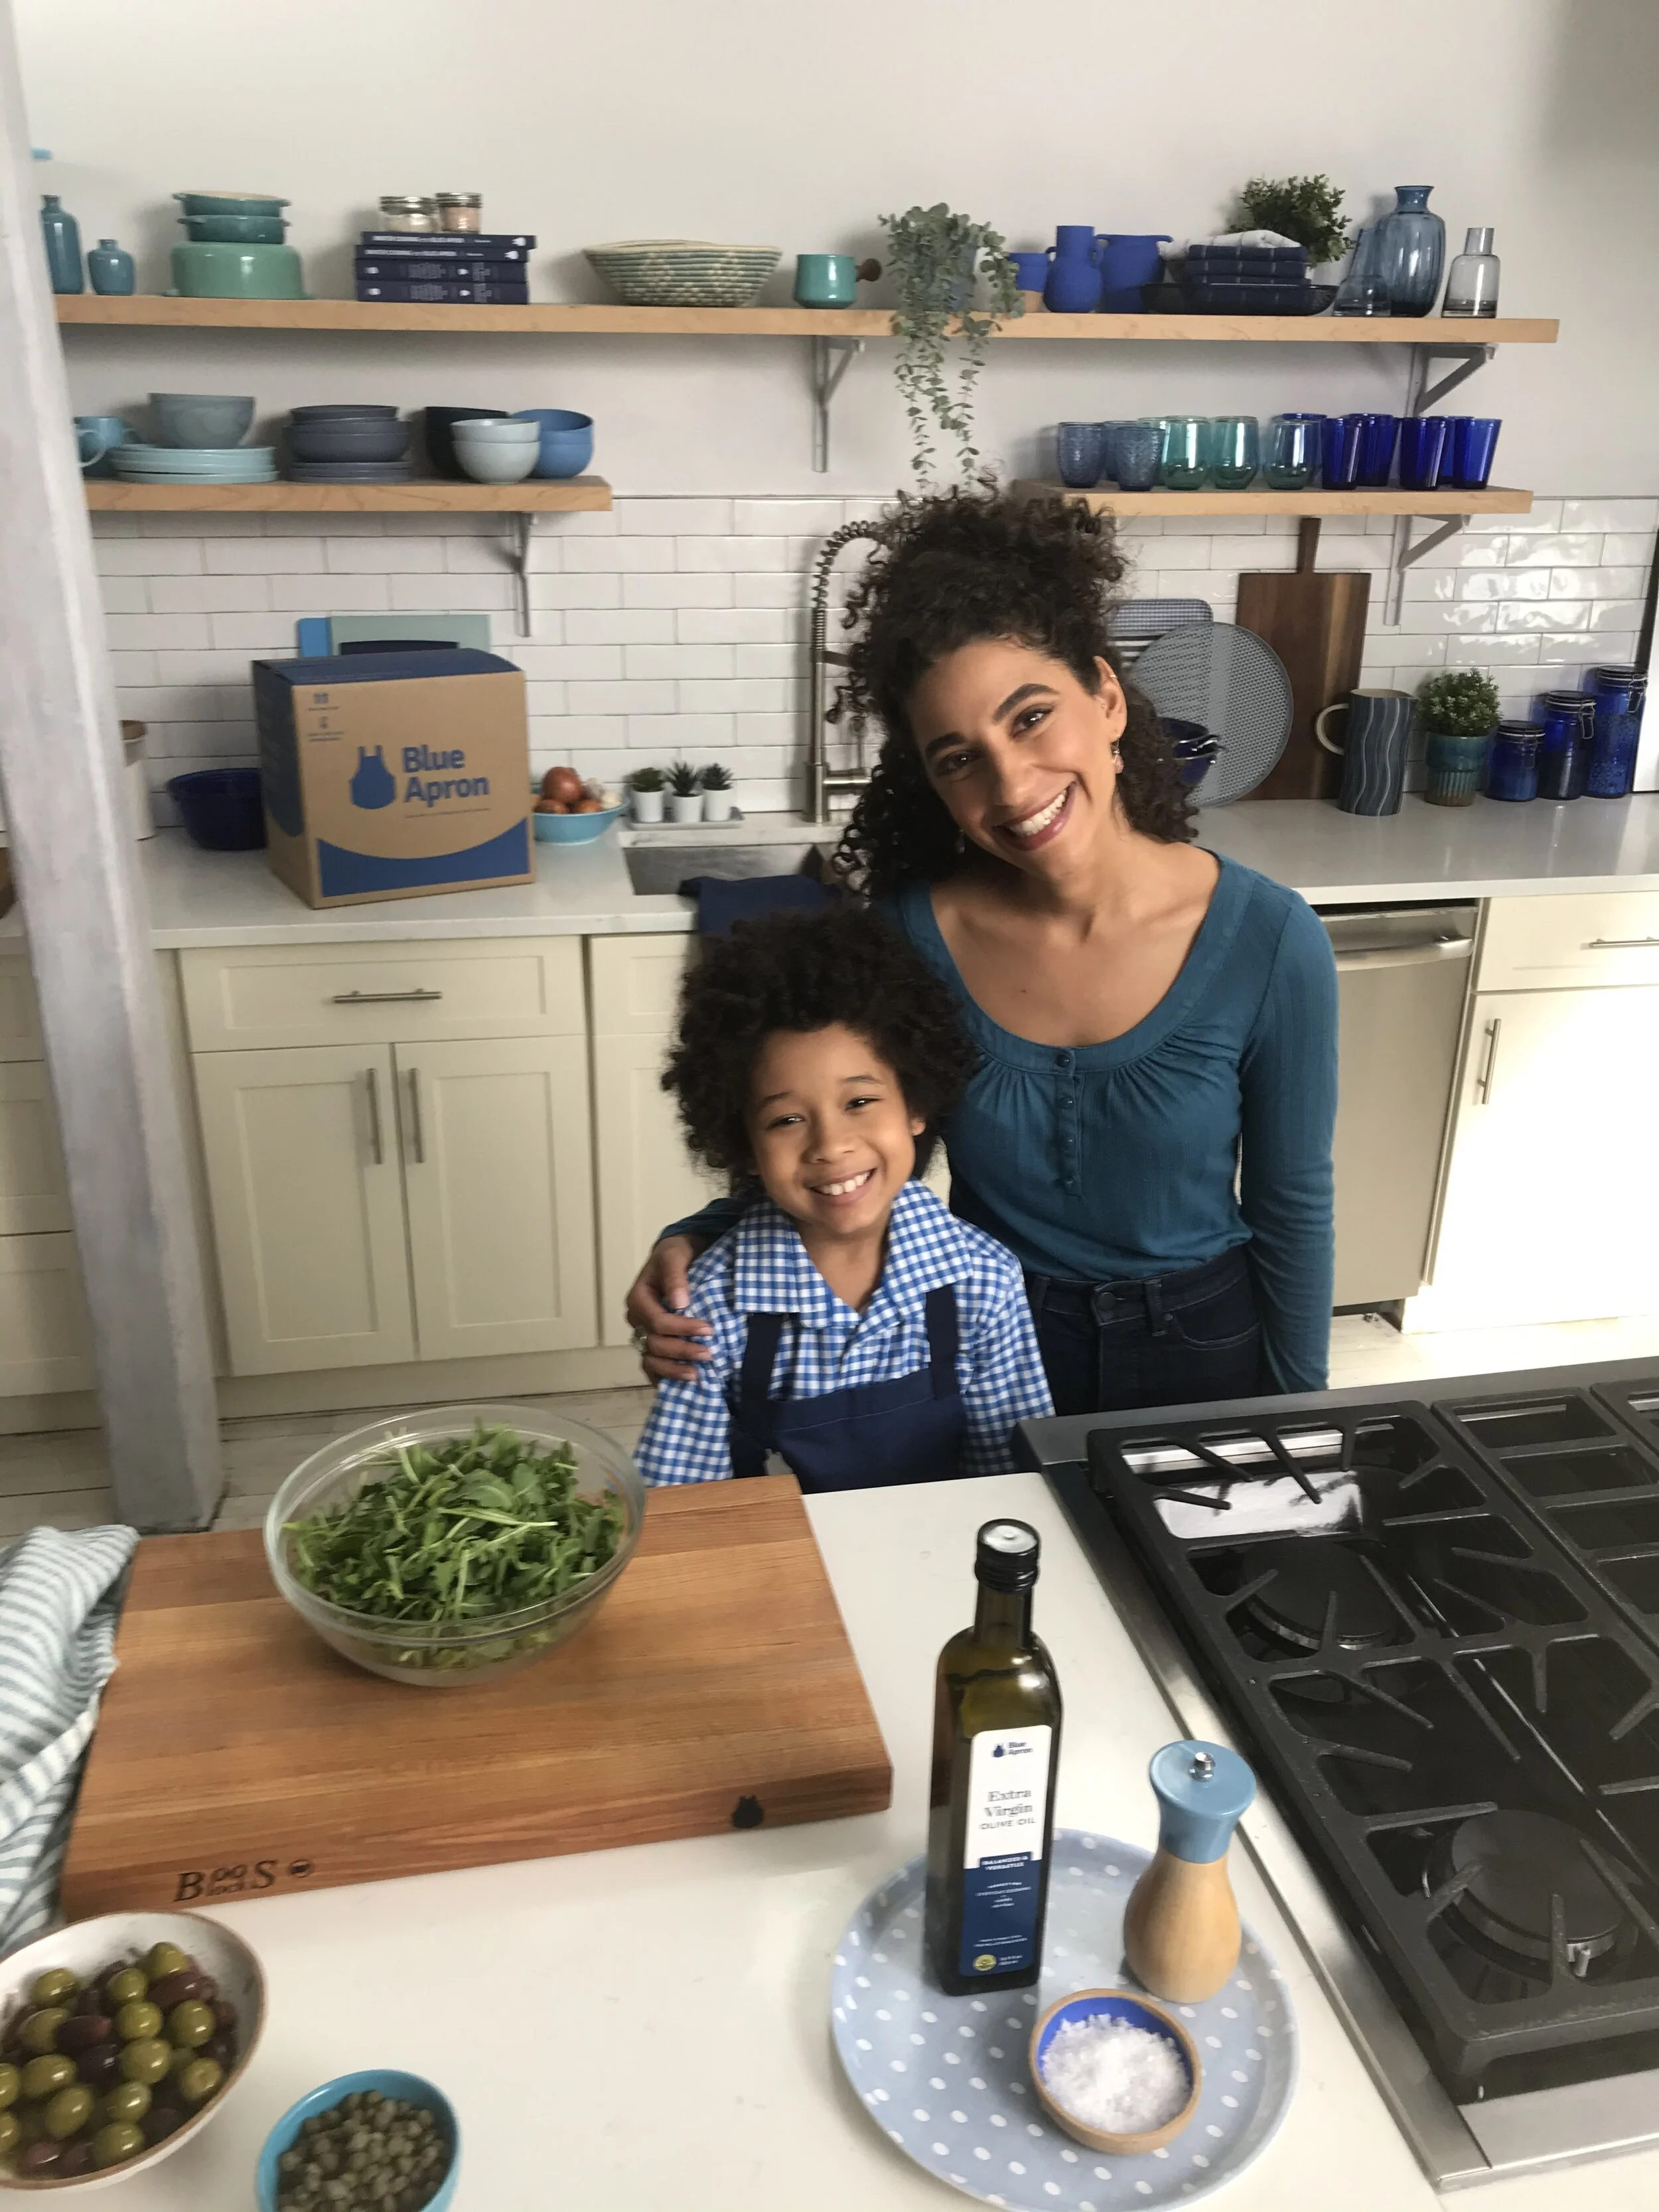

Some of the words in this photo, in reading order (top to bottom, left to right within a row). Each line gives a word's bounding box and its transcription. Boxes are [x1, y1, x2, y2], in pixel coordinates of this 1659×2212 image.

[402, 744, 465, 773] Blue
[403, 776, 490, 808] Apron
[987, 1789, 1032, 1802] Extra
[983, 1803, 1033, 1817] Virgin
[980, 1820, 1014, 1830] OLIVE
